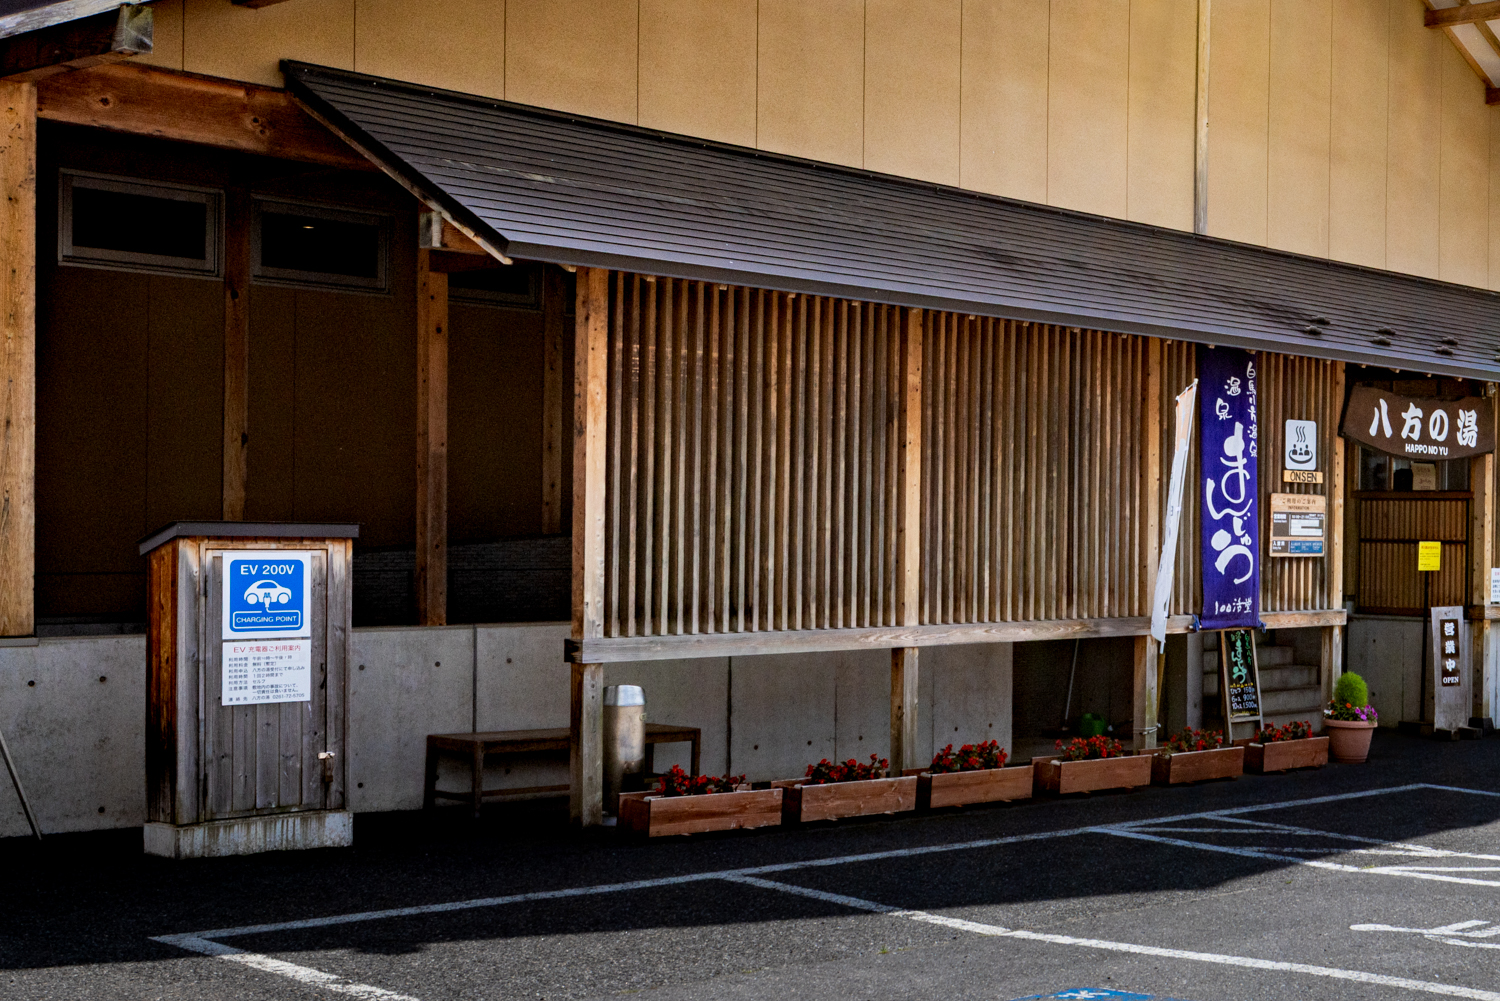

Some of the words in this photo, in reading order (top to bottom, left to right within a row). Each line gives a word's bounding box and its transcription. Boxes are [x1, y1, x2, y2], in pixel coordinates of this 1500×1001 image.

[1369, 398, 1479, 448] 八方の湯
[1405, 443, 1428, 454] HAPPO
[1428, 445, 1438, 455] NO
[1438, 446, 1449, 456] YU
[1290, 471, 1318, 483] ONSEN
[240, 564, 258, 575] EV
[262, 564, 295, 575] 200V
[248, 645, 301, 653] 充電器ご利用案内
[1444, 622, 1456, 672] 営業中
[1442, 676, 1460, 684] OPEN
